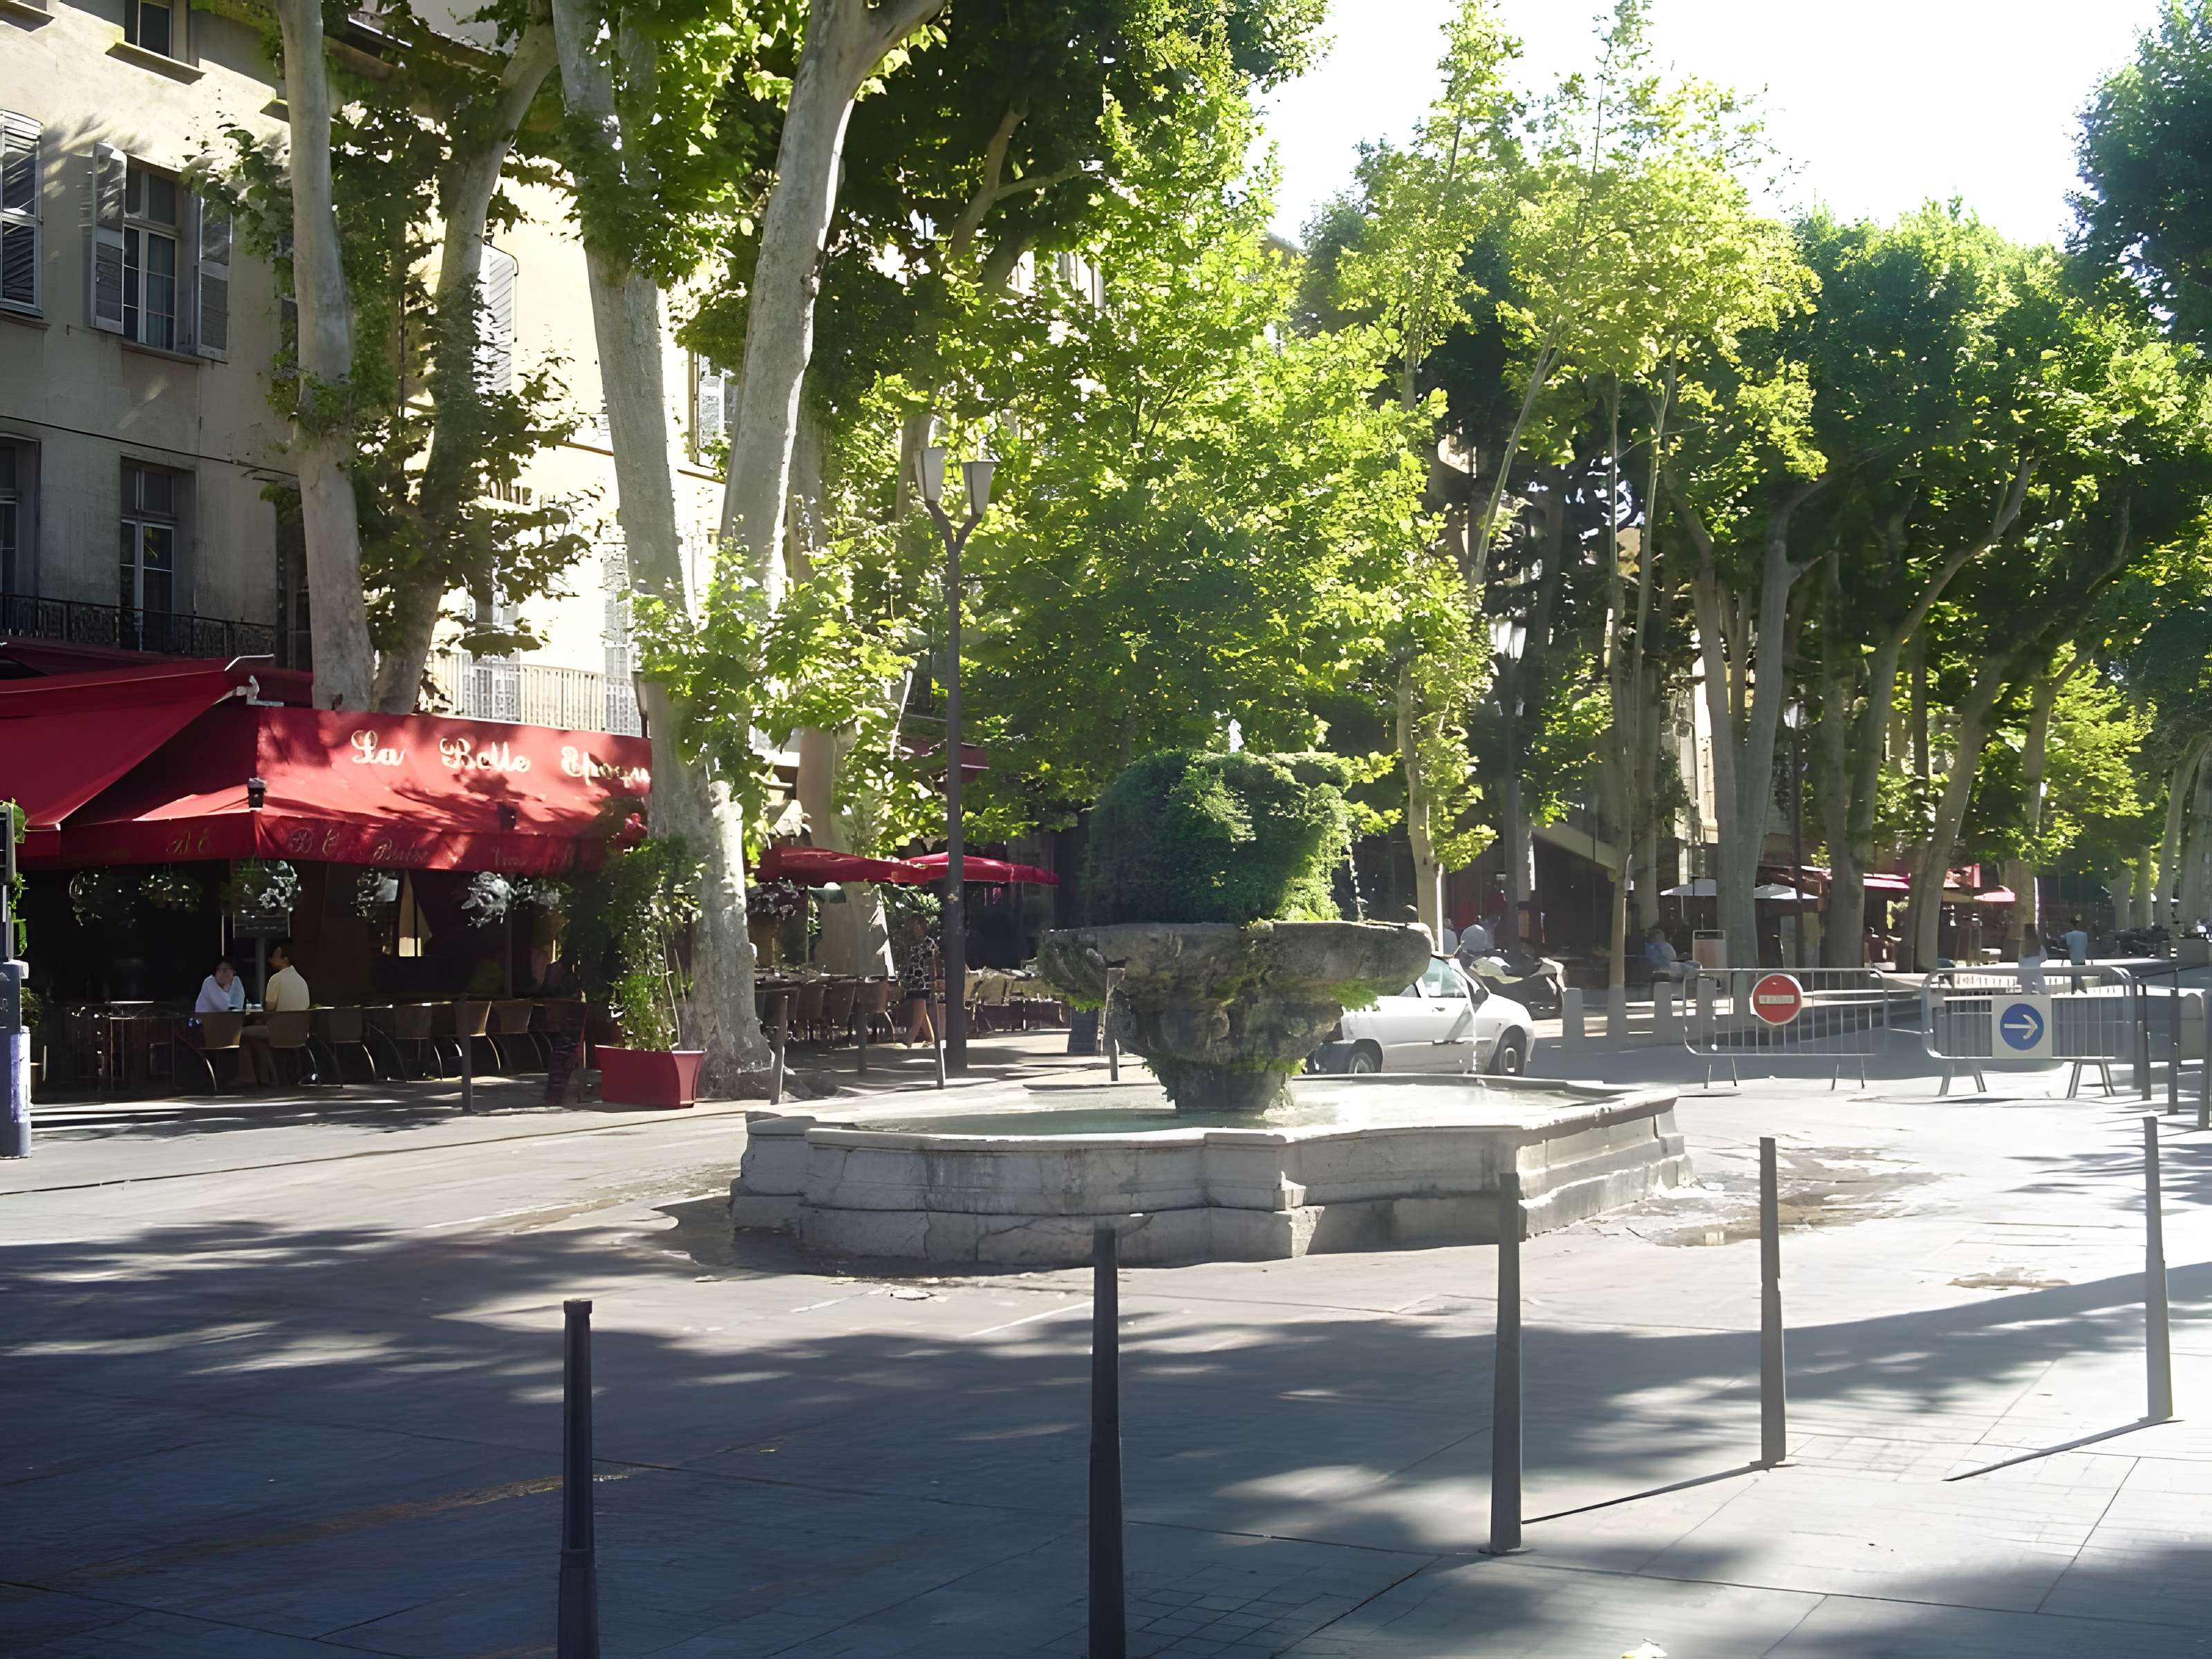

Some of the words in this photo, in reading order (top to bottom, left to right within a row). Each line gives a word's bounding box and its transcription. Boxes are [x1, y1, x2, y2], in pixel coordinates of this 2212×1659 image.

[350, 730, 405, 767] La
[439, 738, 532, 773] Belle
[561, 745, 651, 789] Epoqu
